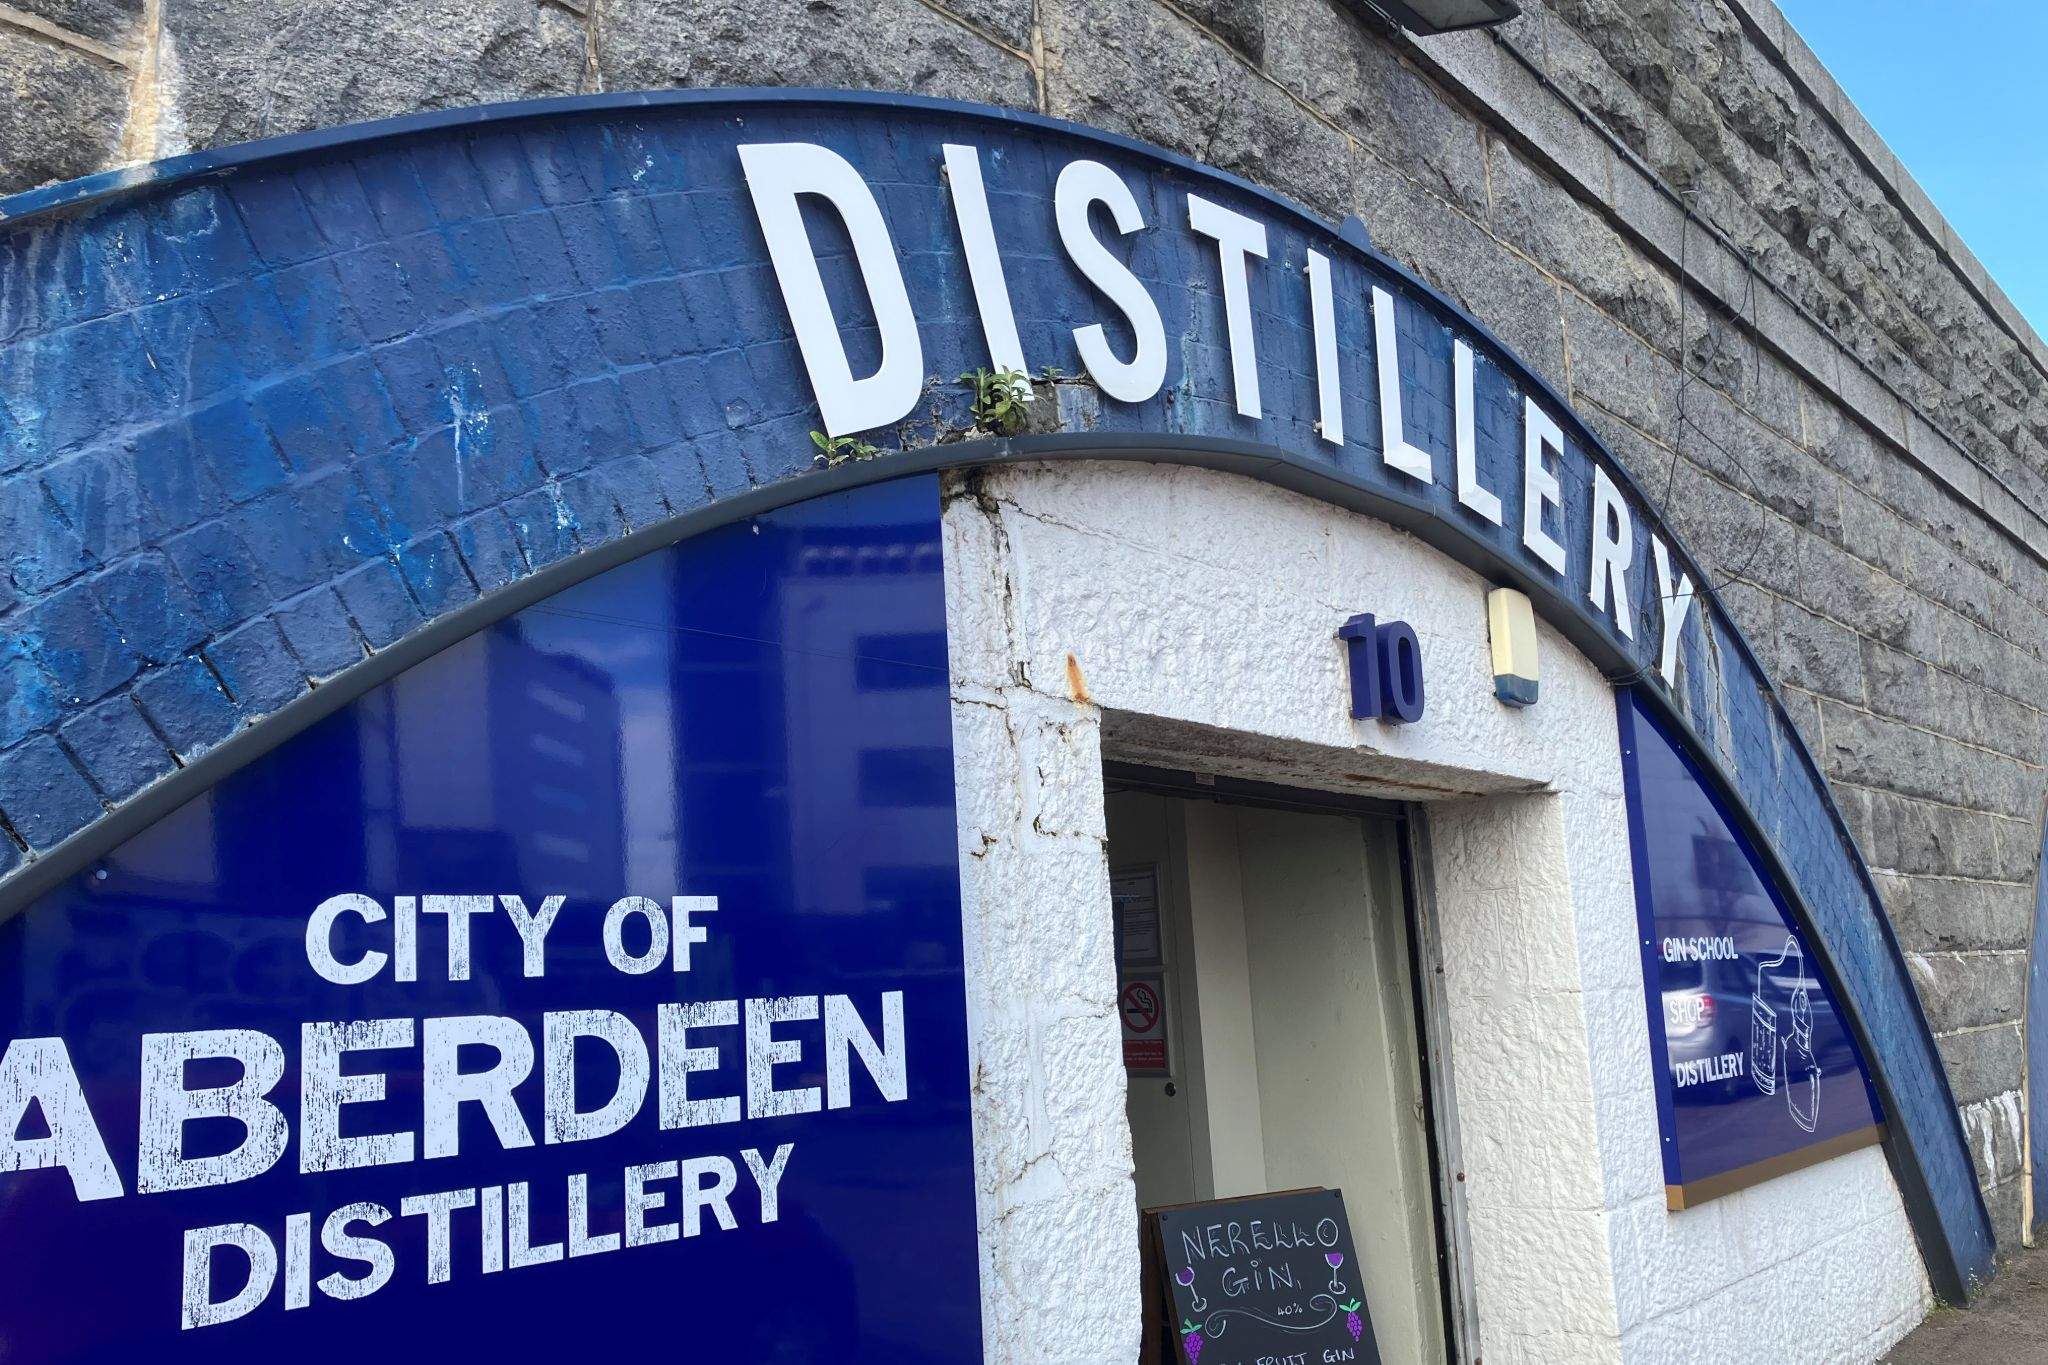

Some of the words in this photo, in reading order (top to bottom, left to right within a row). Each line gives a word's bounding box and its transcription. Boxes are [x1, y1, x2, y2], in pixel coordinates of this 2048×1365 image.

[737, 142, 1694, 690] DISTILLERY
[1338, 613, 1425, 723] 10
[305, 893, 566, 985] CITY
[603, 894, 719, 975] OF
[1670, 998, 1705, 1024] SHOP
[0, 990, 908, 1202] ABERDEEN
[1675, 1051, 1744, 1088] DISTILLERY
[181, 1143, 794, 1331] DISTILLERY
[1181, 1218, 1339, 1264] NERELLO
[1277, 1302, 1303, 1316] 40%
[1322, 1347, 1355, 1363] GIN
